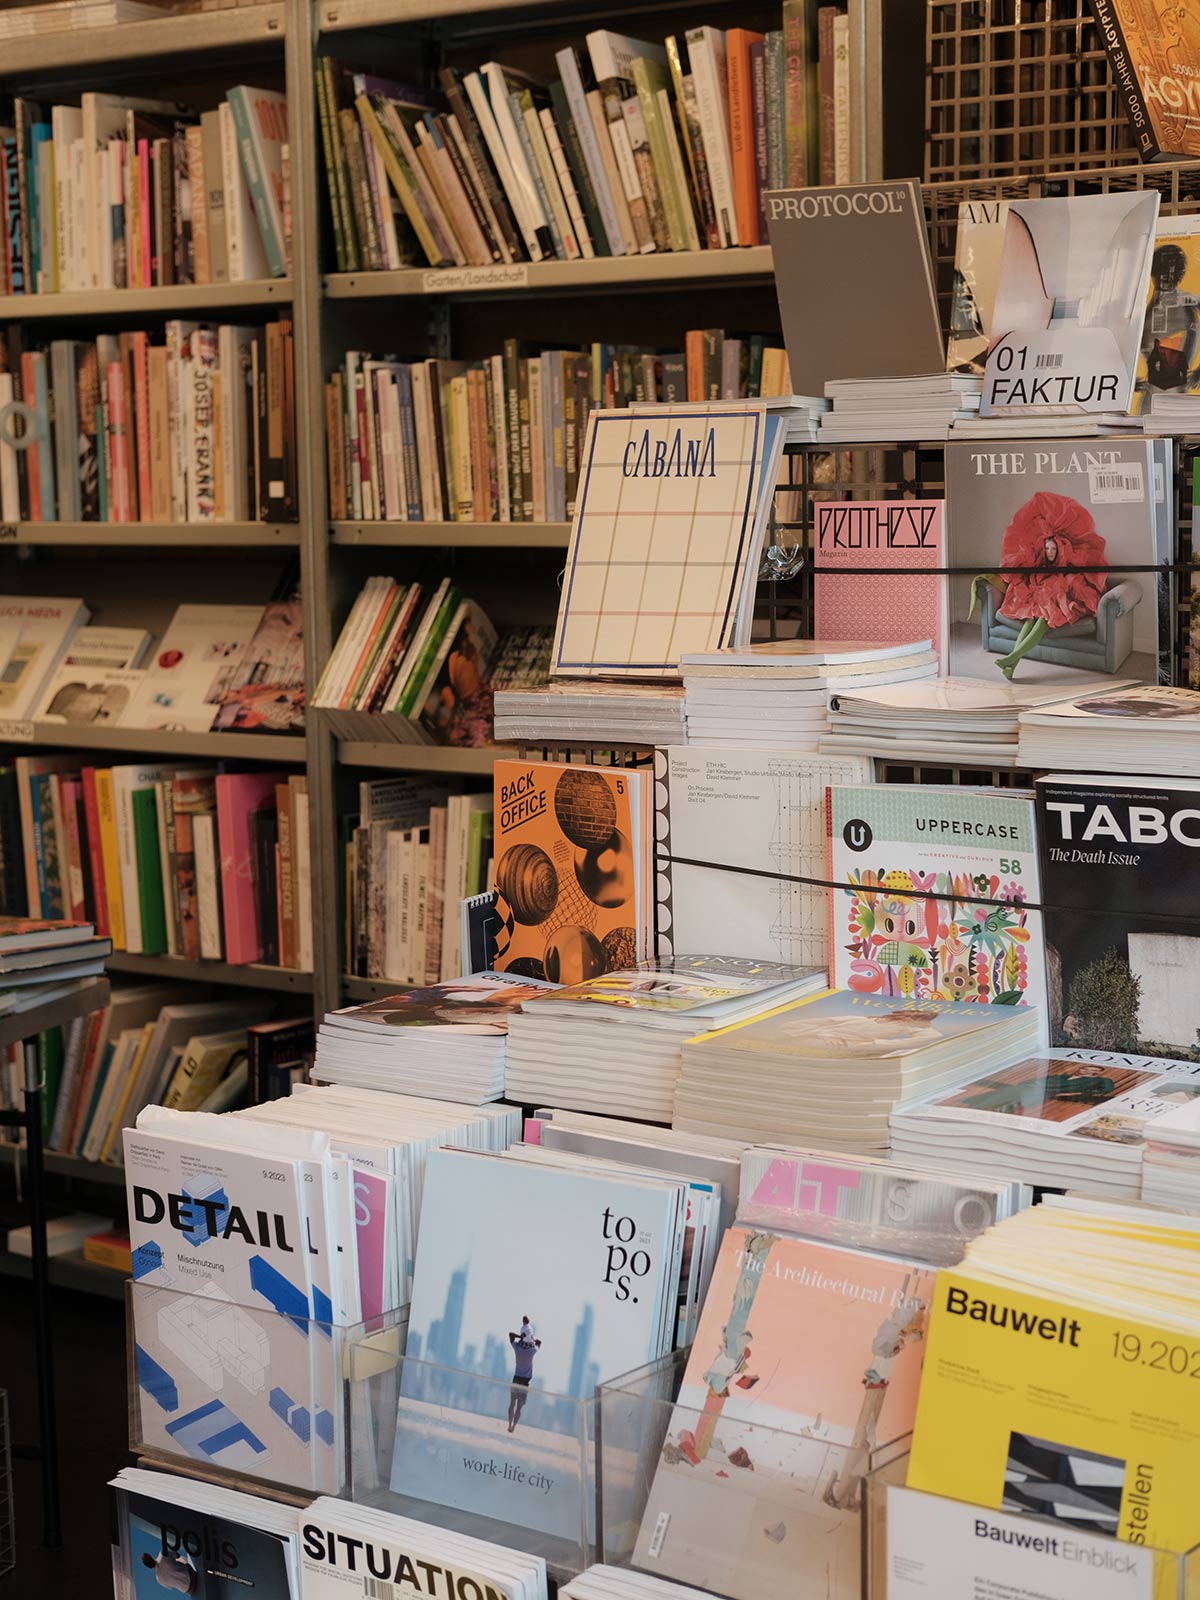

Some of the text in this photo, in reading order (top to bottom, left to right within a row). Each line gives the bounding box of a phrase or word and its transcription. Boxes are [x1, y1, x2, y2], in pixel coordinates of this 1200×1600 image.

[754, 56, 764, 116] MENSCHEN
[1113, 51, 1135, 92] JAHRE
[734, 113, 742, 132] des
[1129, 94, 1146, 128] 5000
[735, 135, 743, 153] Lob
[191, 132, 207, 234] PAPANEK
[769, 191, 903, 220] PROTOCOL
[425, 267, 526, 288] Garten/Landschaft
[997, 345, 1028, 372] 01
[990, 374, 1120, 405] FAKTUR
[622, 427, 717, 479] CABANA
[970, 452, 1027, 476] THE
[819, 506, 937, 549] PROTHESE
[819, 550, 848, 559] Magazin
[501, 770, 535, 804] BACK
[616, 780, 624, 795] 5
[1045, 789, 1073, 797] Independent
[501, 789, 547, 828] OFFICE
[279, 812, 291, 854] JENS
[915, 818, 1020, 840] UPPERCASE
[929, 852, 960, 860] CREATIVE
[966, 855, 994, 863] CURIOUS
[999, 858, 1022, 876] 58
[1050, 848, 1141, 866] The Death Issue
[262, 1170, 287, 1183] 9.2023
[132, 1185, 295, 1254] DETAIL
[601, 1206, 636, 1243] to
[176, 1253, 225, 1273] Mischnutzung
[178, 1265, 198, 1278] Mixed
[199, 1269, 213, 1281] Use
[602, 1244, 651, 1284] po
[735, 1250, 766, 1274] The
[769, 1261, 885, 1304] Architectural
[946, 1286, 1082, 1348] Bauwelt
[462, 1456, 555, 1495] work-life city
[1128, 1463, 1154, 1546] stellen
[160, 1520, 240, 1570] polis
[974, 1519, 1138, 1577] Bauwelt Einblick
